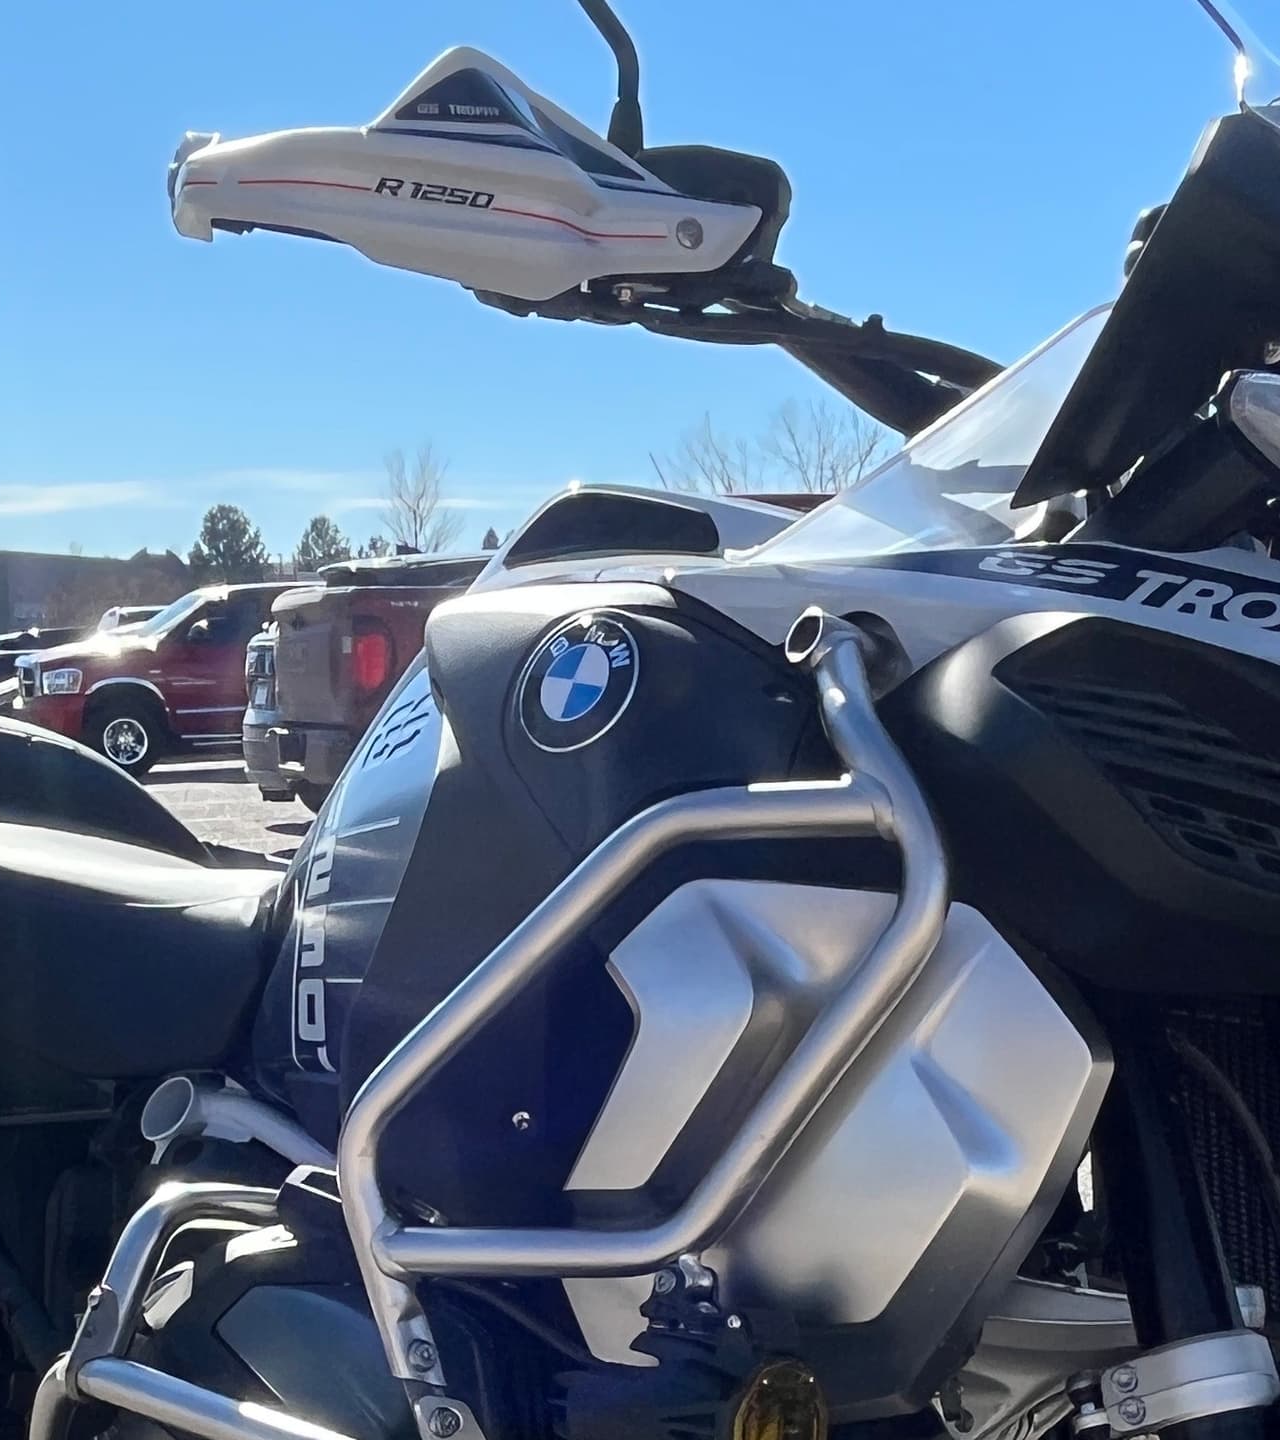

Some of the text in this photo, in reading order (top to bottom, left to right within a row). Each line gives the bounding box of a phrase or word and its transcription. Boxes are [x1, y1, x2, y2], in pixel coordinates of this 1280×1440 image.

[374, 176, 496, 209] R 1250
[978, 551, 1120, 585] GS
[549, 623, 631, 668] BMW
